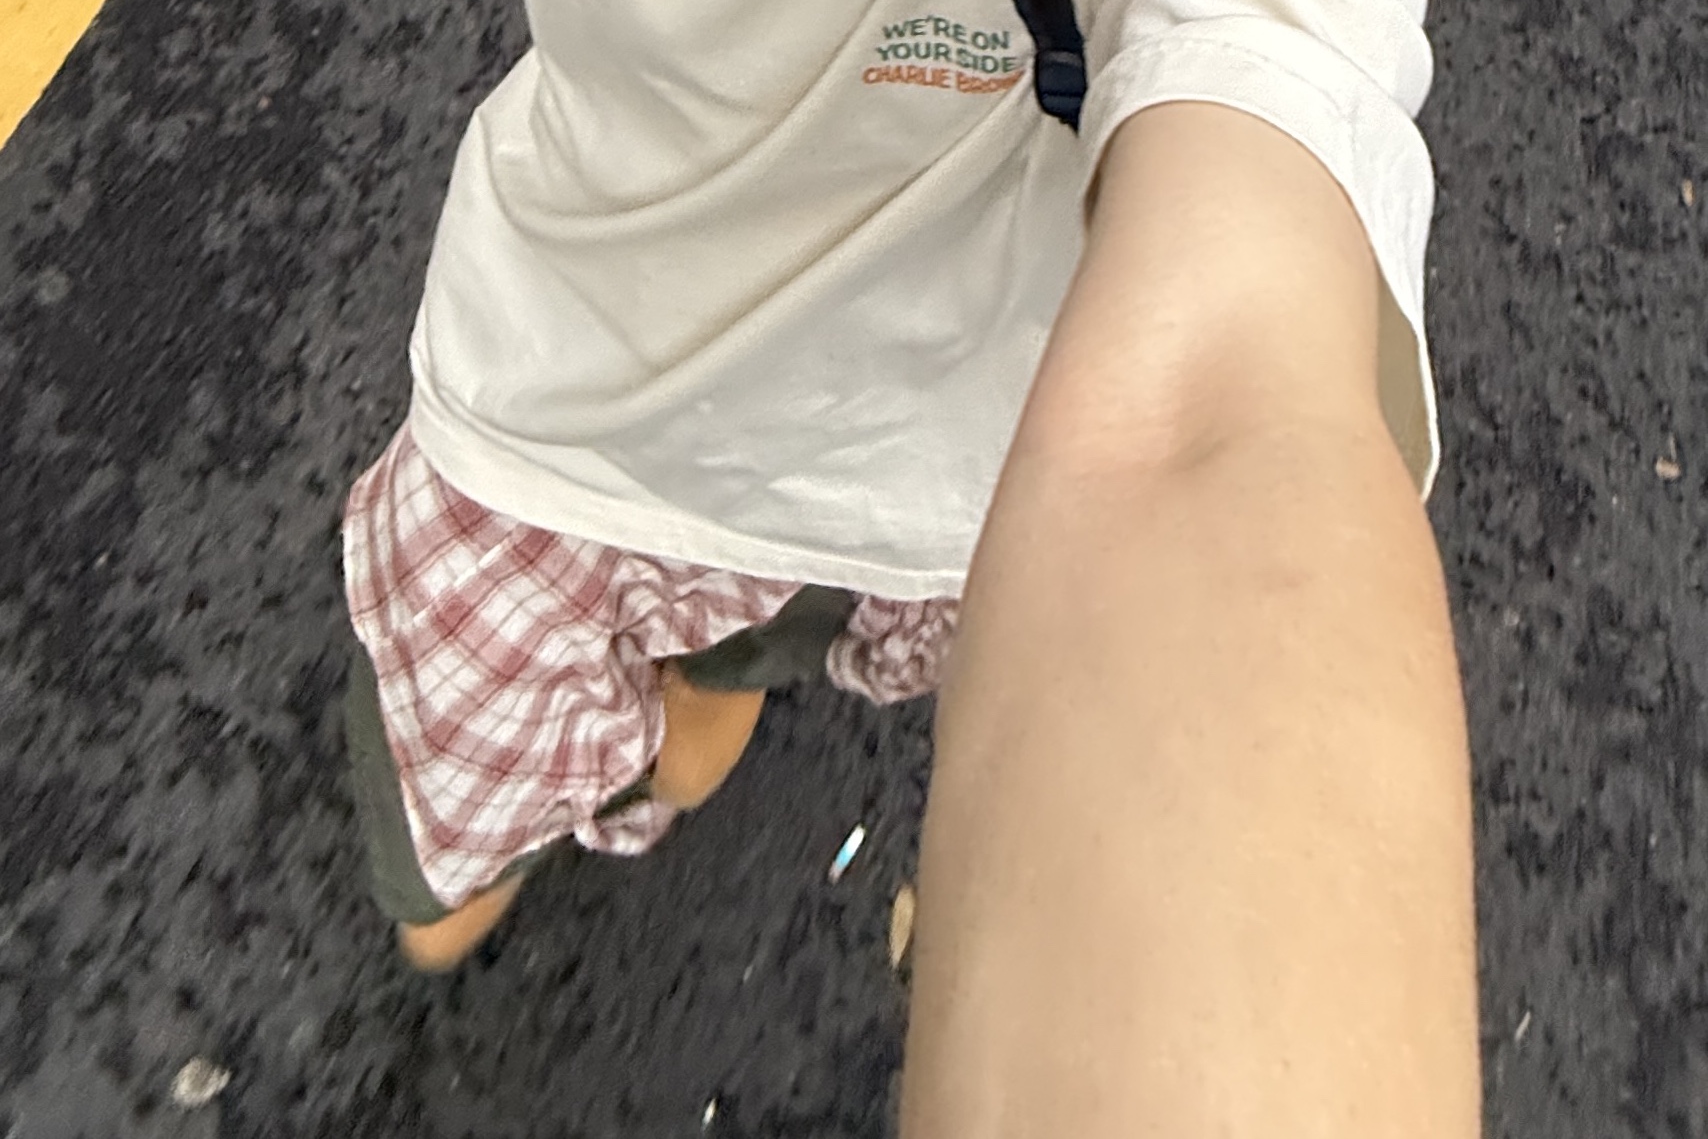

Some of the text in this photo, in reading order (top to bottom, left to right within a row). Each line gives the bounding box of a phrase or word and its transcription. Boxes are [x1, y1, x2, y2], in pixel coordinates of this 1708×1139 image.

[883, 16, 1010, 50] WE'RE ON
[876, 43, 1016, 73] YOUR SIDE
[863, 65, 951, 88] CHARLIE
